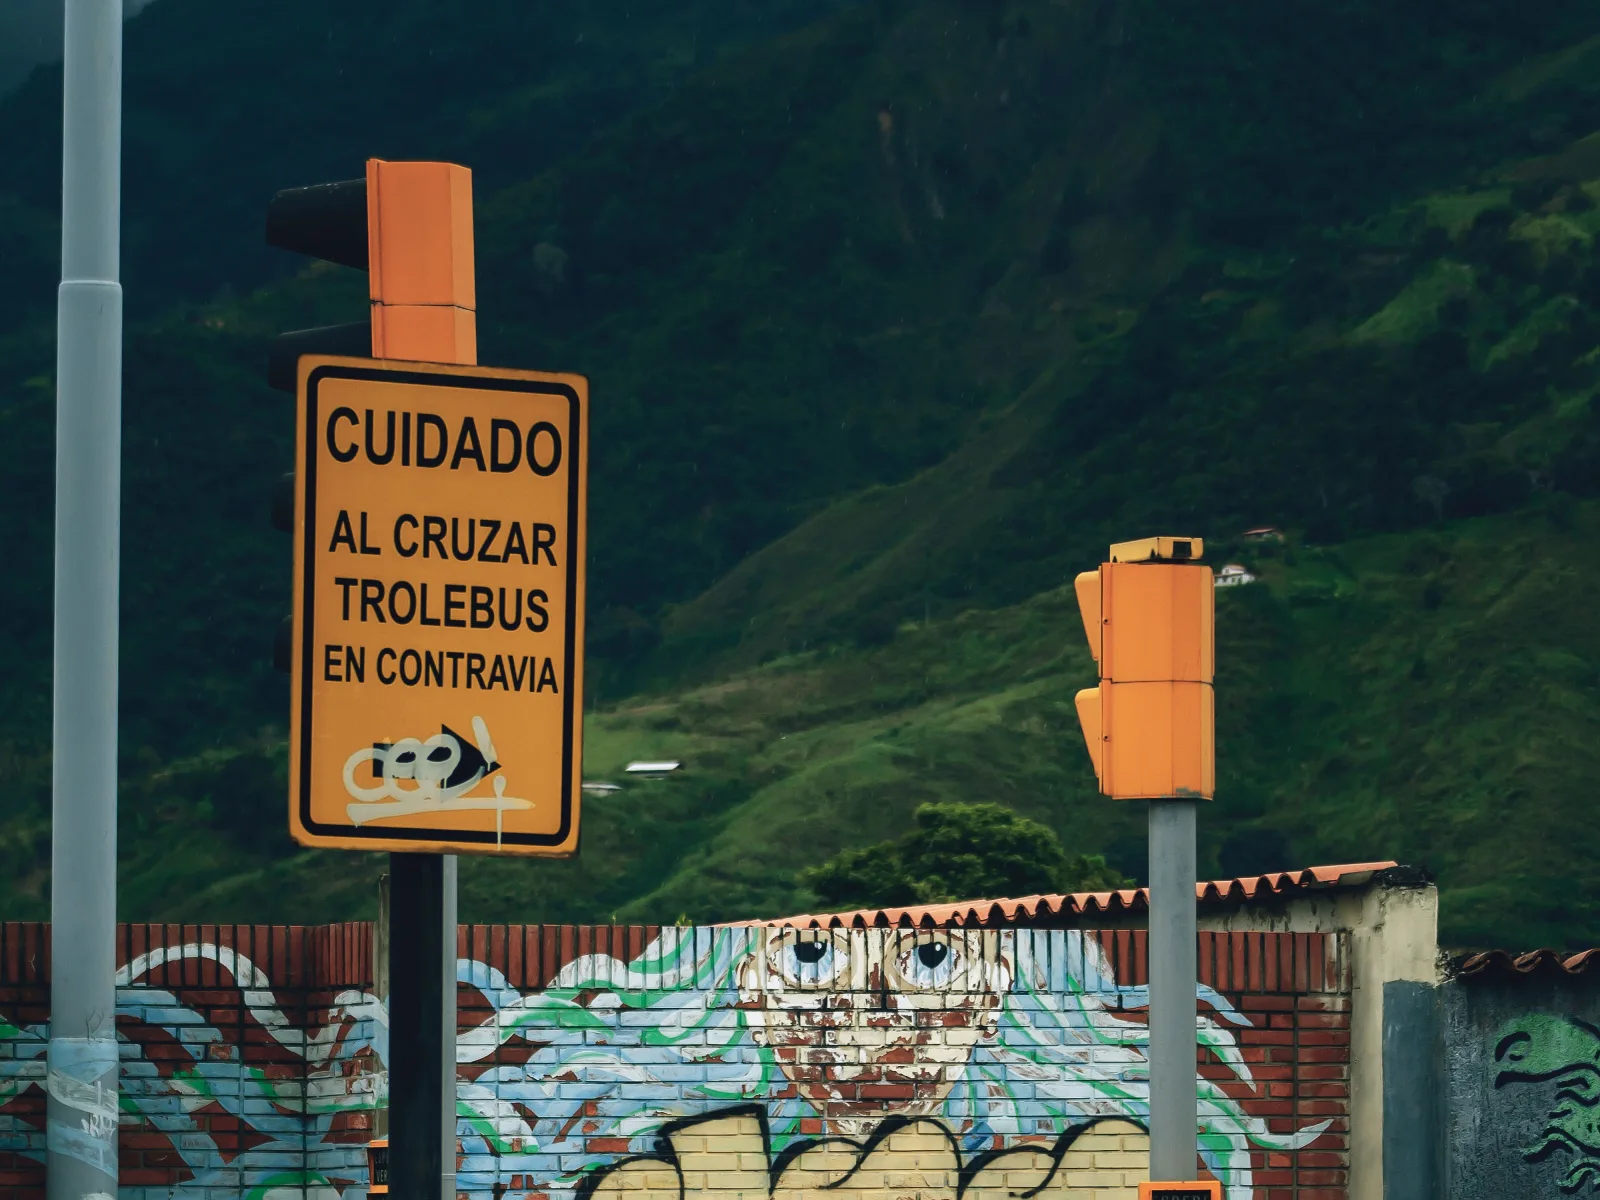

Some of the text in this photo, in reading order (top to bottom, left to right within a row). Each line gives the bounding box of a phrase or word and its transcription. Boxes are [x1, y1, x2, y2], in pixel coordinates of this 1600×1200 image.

[326, 406, 563, 477] CUIDADO
[328, 509, 558, 567] AL CRUZAR
[334, 576, 549, 633] TROLEBUS
[323, 644, 559, 694] EN CONTRAVIA
